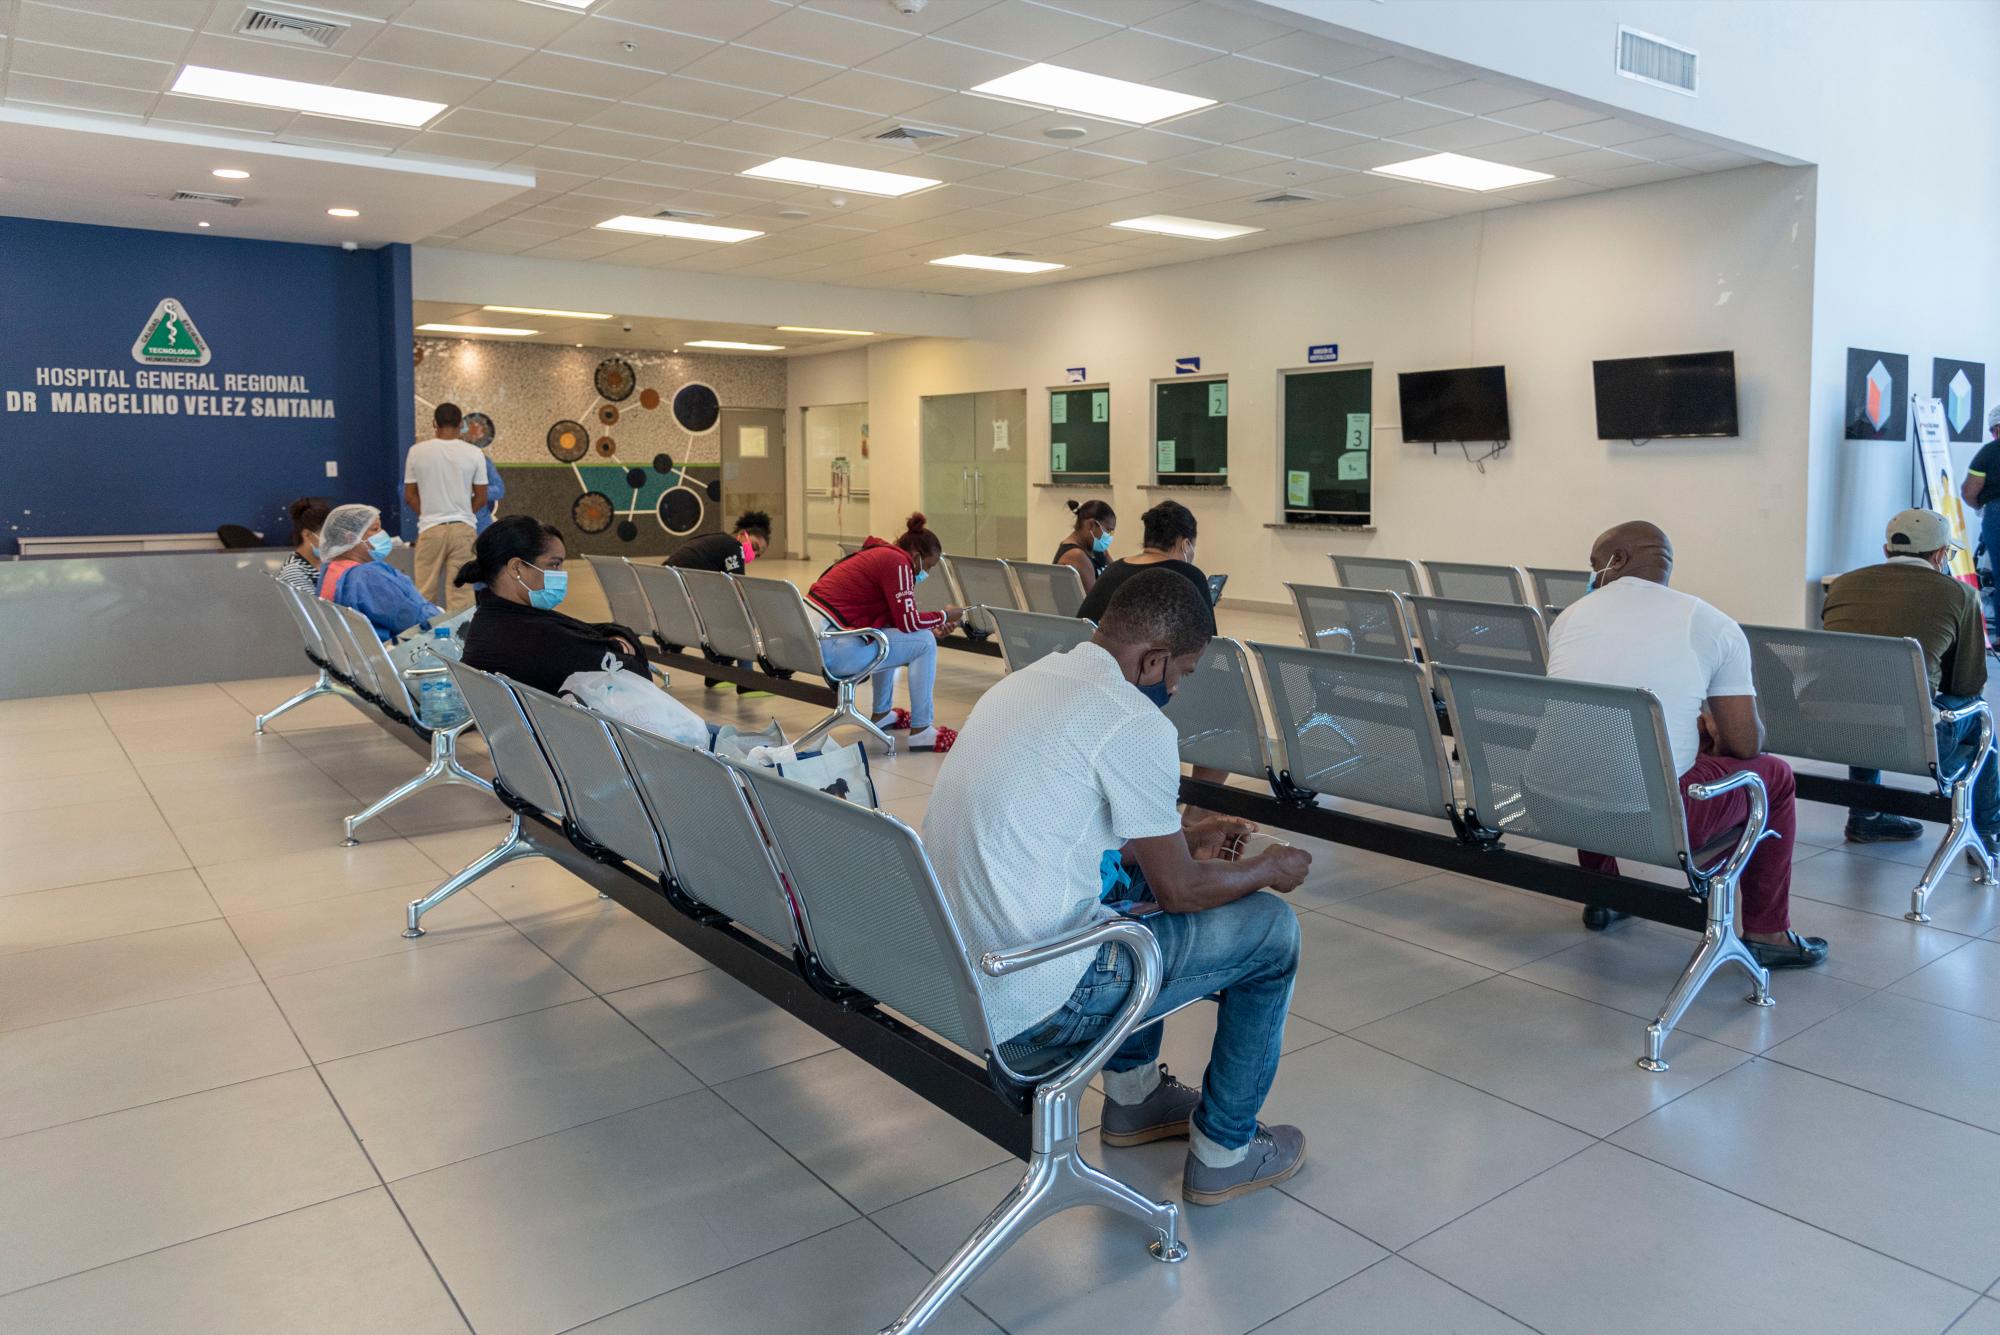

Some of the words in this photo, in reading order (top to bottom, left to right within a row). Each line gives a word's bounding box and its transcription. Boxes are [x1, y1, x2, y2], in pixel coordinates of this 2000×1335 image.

[148, 347, 197, 355] TECNOLOGIA
[36, 367, 130, 388] HOSPITAL
[136, 370, 219, 391] GENERAL
[224, 373, 310, 393] REGIONAL
[6, 391, 37, 412] DR
[51, 391, 179, 415] MARCELINO
[184, 395, 246, 417] VELEZ
[251, 397, 335, 419] SANTANA
[1097, 402, 1104, 420] 1
[1214, 398, 1222, 415] 2
[1352, 430, 1362, 447] 3
[1055, 453, 1062, 470] 1
[905, 598, 914, 612] R
